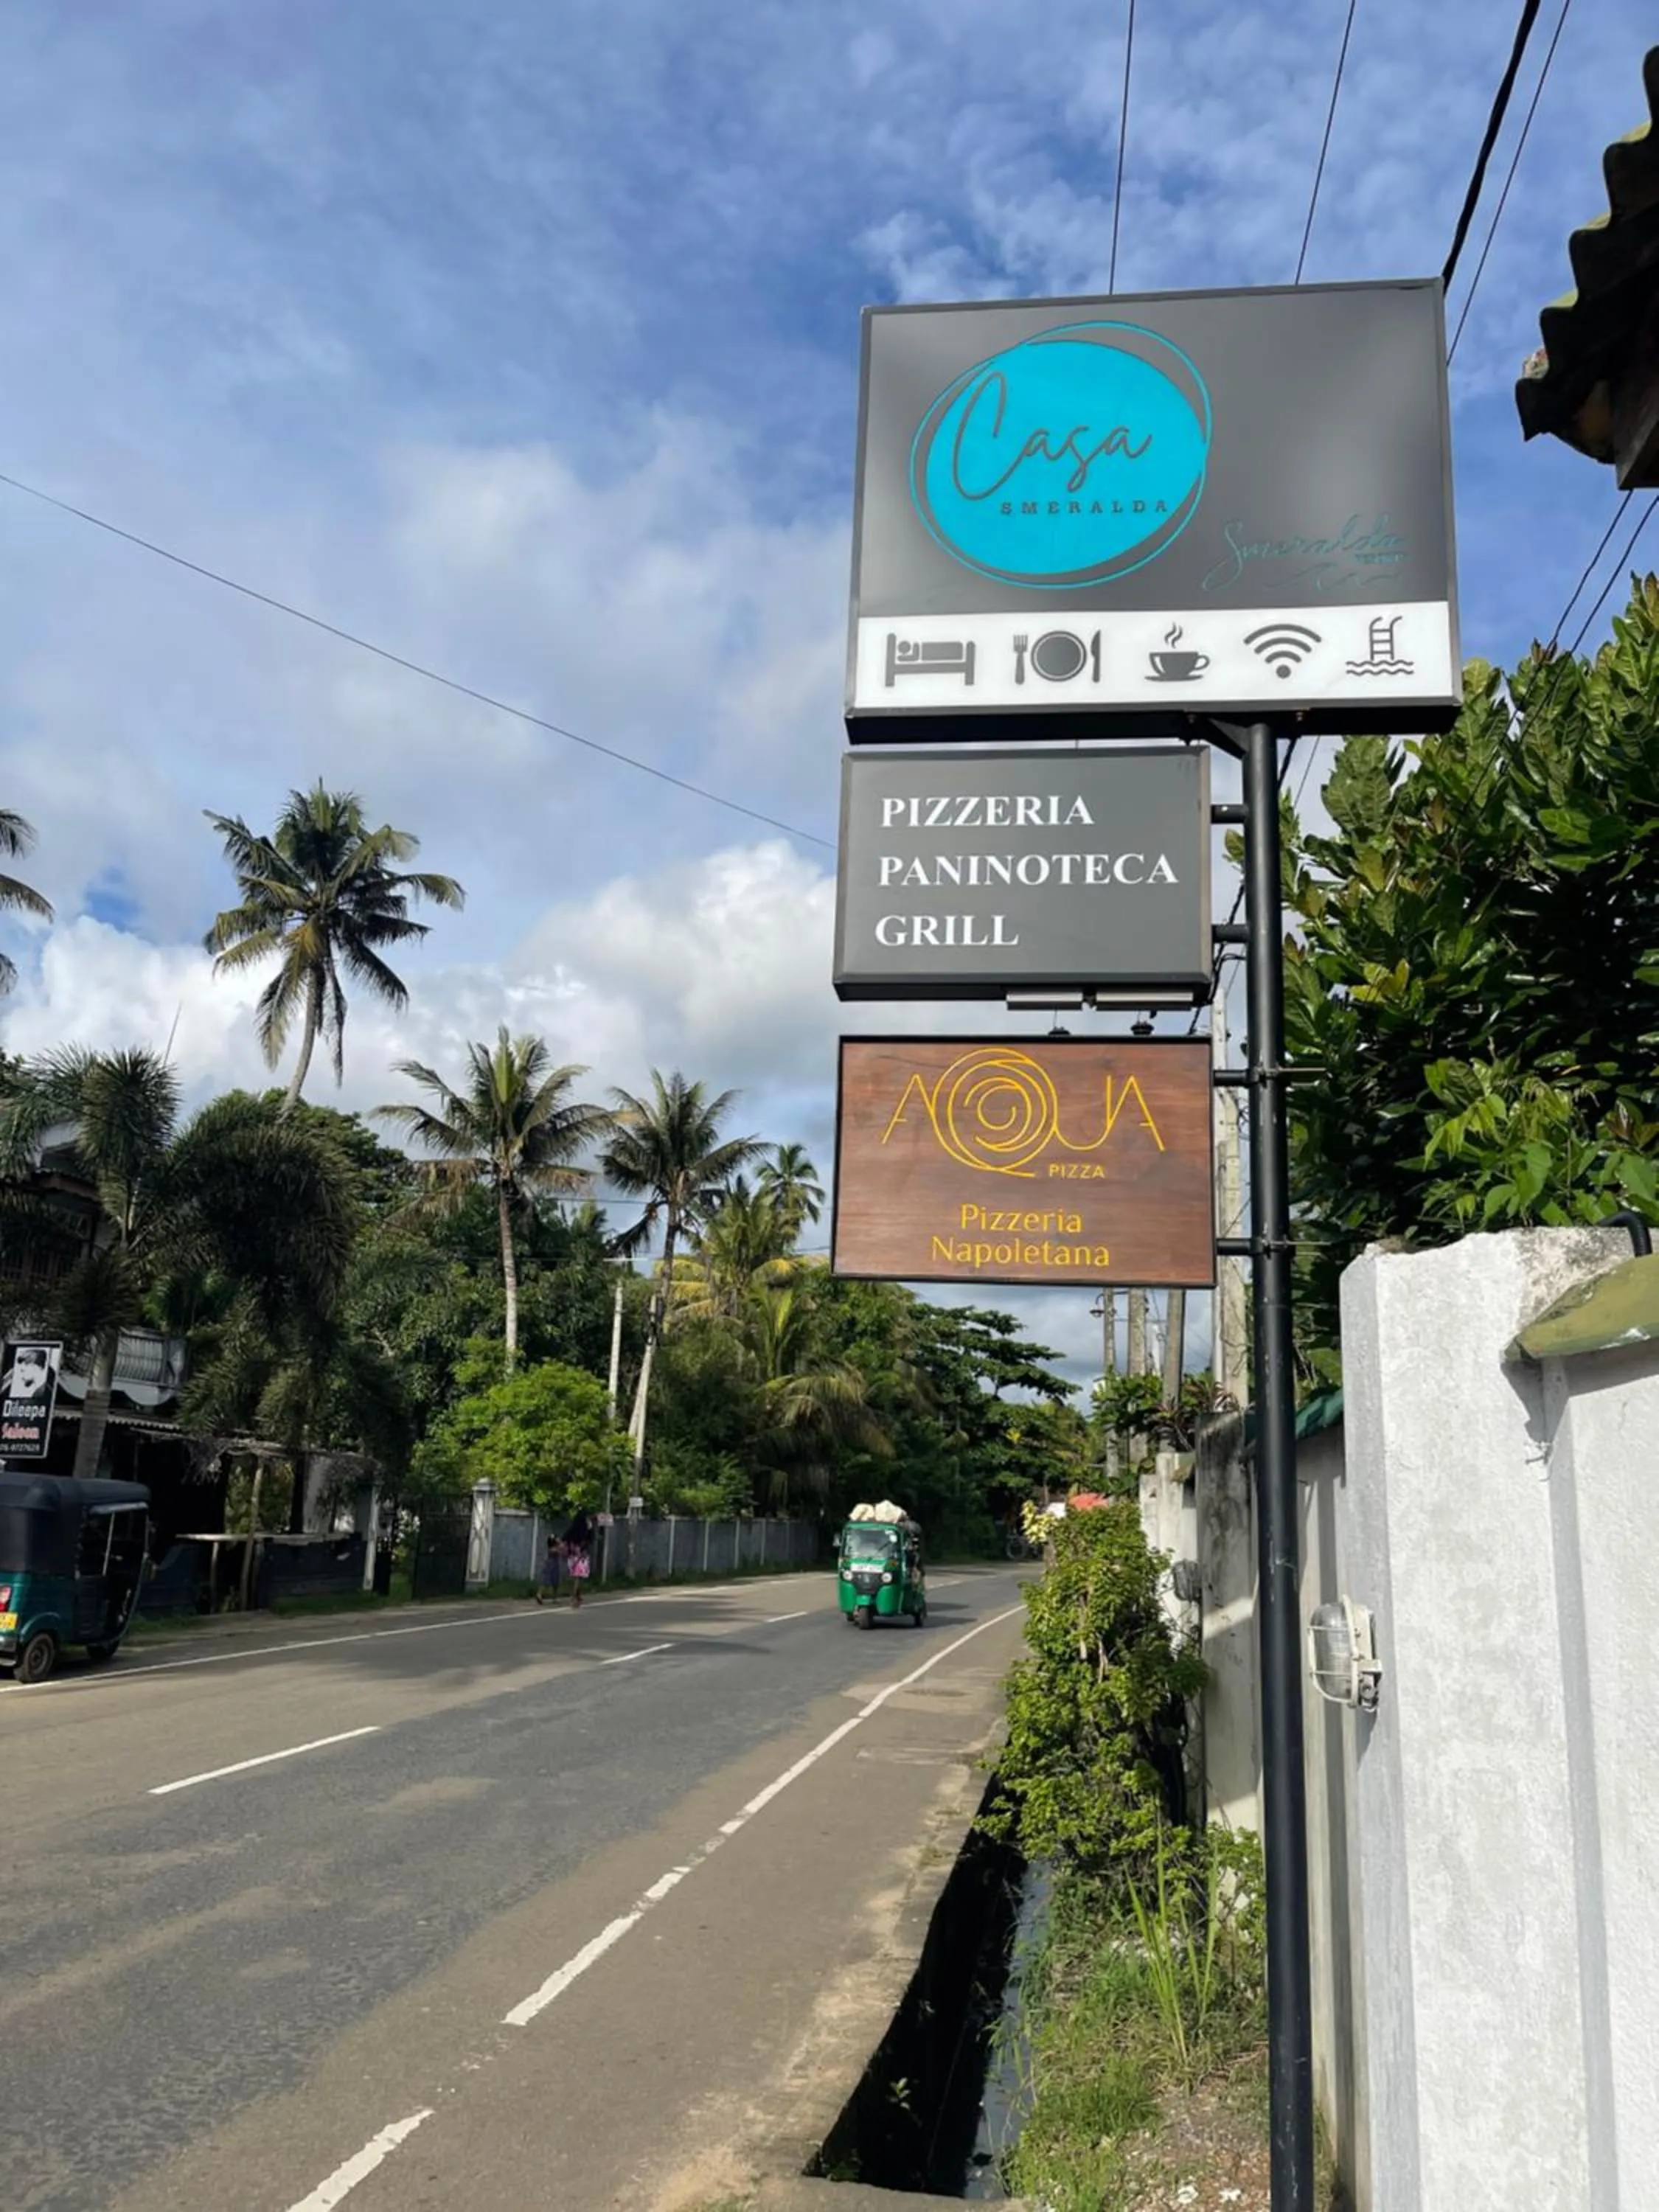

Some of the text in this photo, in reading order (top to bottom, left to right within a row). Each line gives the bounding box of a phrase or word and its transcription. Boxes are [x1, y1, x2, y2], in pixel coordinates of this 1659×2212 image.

[952, 371, 1152, 501] Casa
[1000, 500, 1168, 515] SMERALDA
[881, 795, 1095, 827] PIZZERIA
[879, 853, 1180, 886] PANINOTECA
[874, 914, 1020, 946] GRILL
[881, 1047, 1166, 1178] AQUA
[1048, 1163, 1106, 1179] PIZZA
[960, 1203, 1082, 1234] Pizzeria
[931, 1236, 1110, 1268] Napoletana
